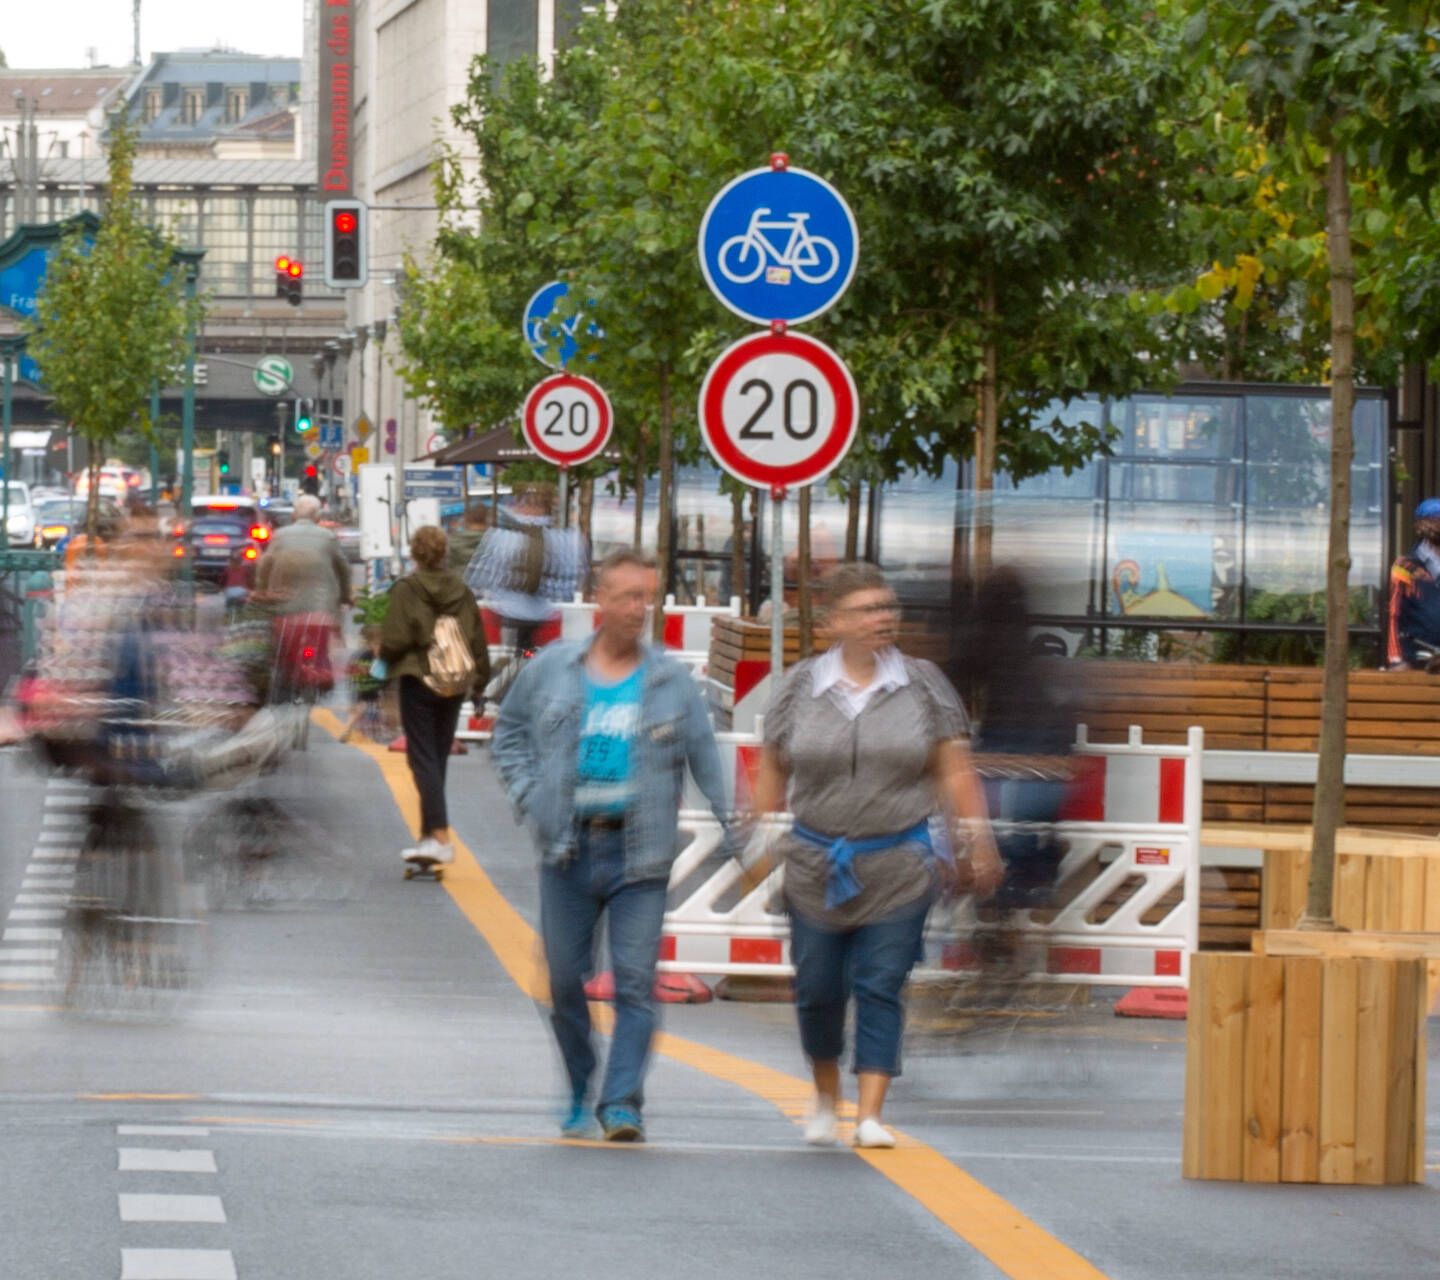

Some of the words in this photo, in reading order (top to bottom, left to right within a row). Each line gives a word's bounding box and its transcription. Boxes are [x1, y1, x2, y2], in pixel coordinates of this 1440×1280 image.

[327, 15, 350, 57] das
[323, 61, 350, 192] Dussmann
[543, 401, 589, 437] 20
[739, 378, 818, 441] 20
